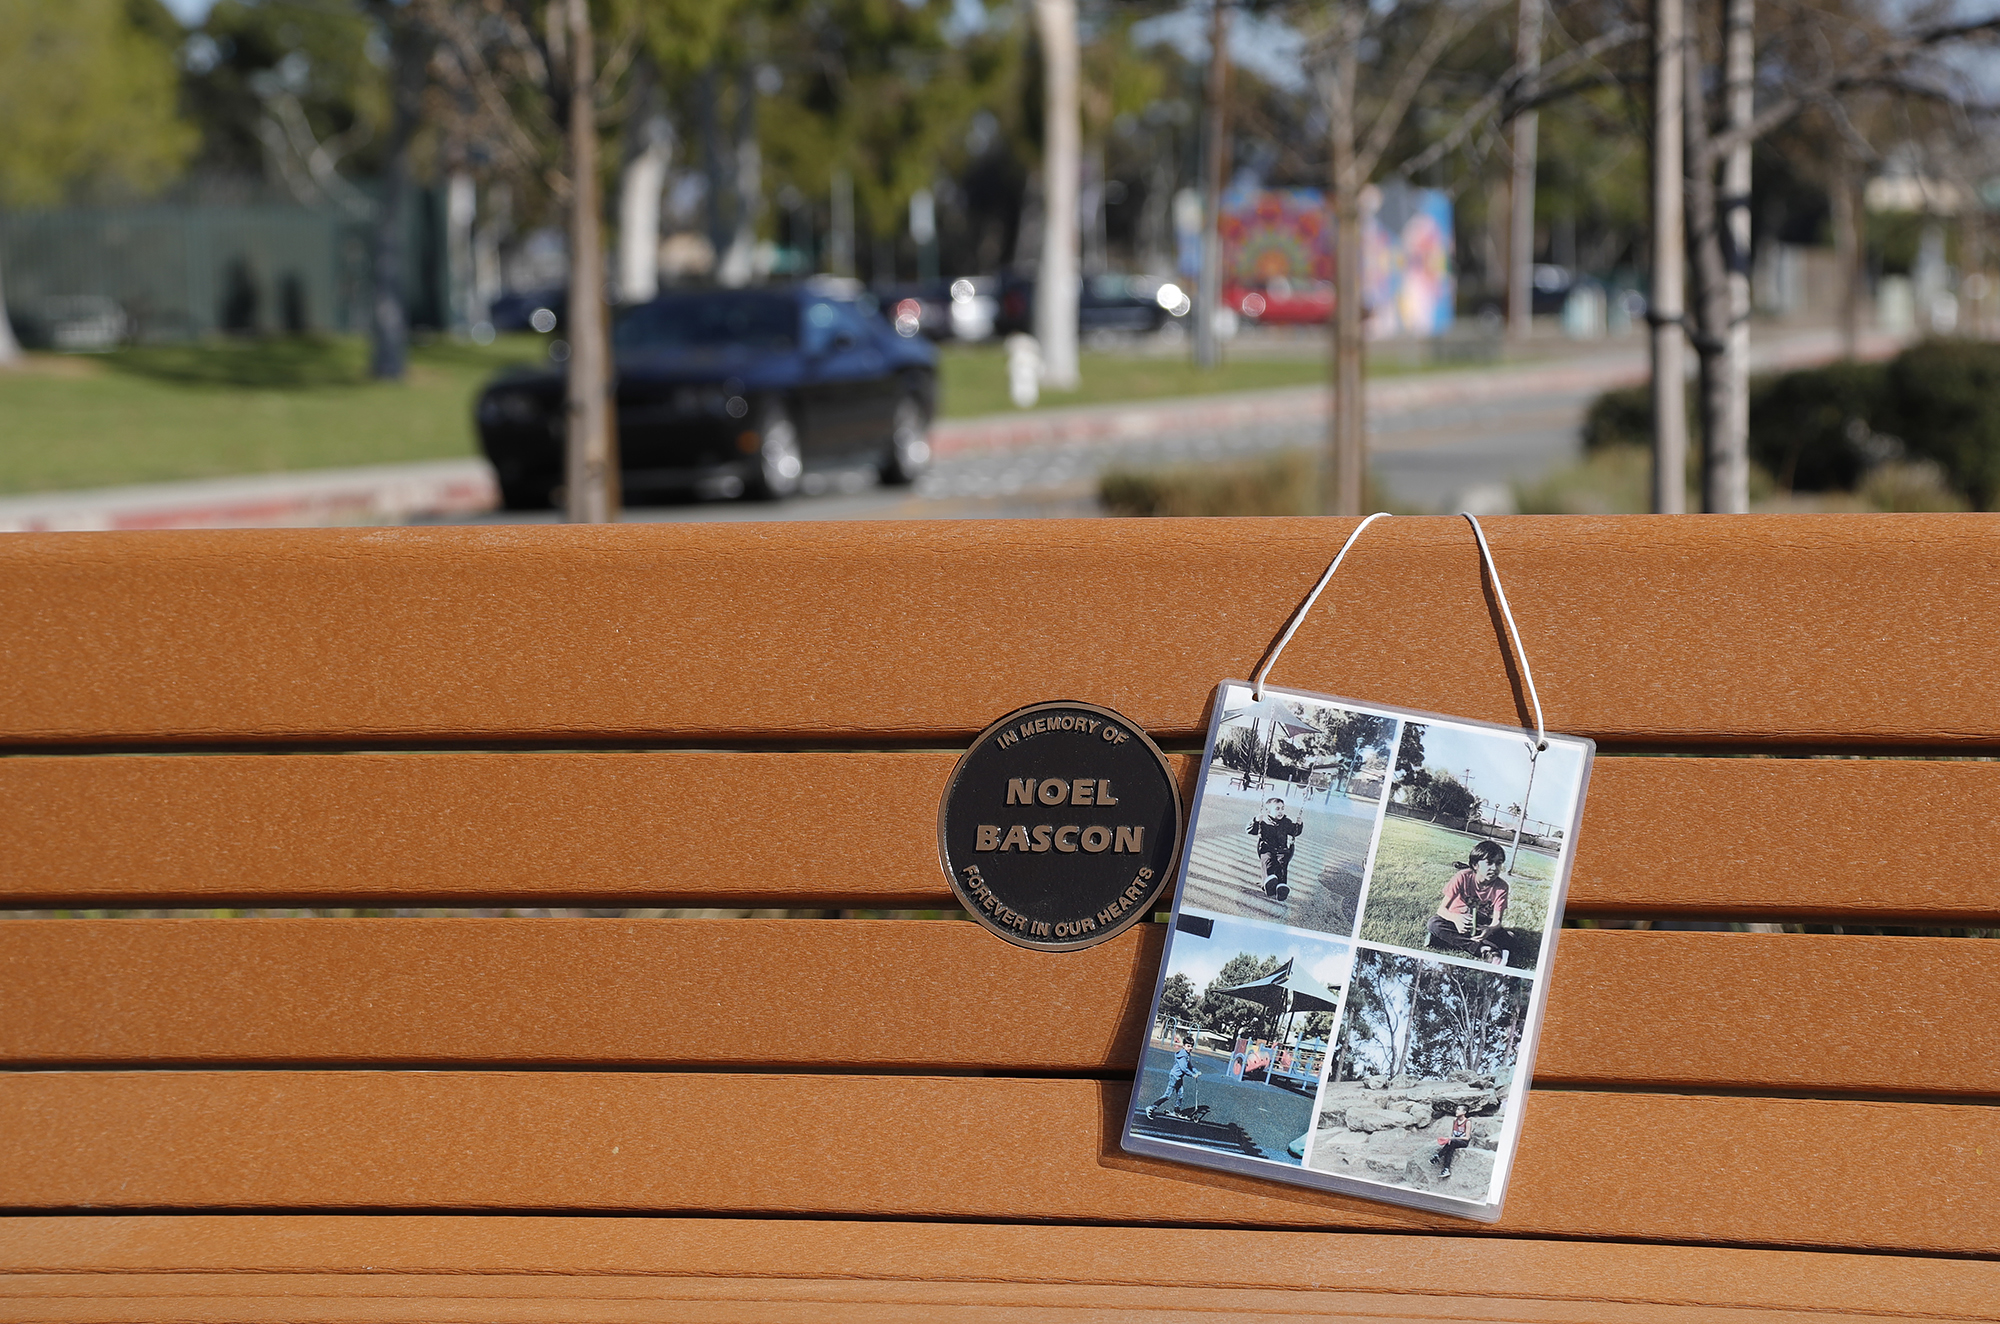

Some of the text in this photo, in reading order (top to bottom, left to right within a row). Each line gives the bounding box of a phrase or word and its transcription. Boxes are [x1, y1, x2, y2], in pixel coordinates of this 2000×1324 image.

[997, 717, 1128, 749] IN MEMORY OF
[1006, 778, 1118, 805] NOEL
[976, 825, 1144, 853] BASCON
[963, 864, 1154, 937] FOREVER IN OUR HEARTS
